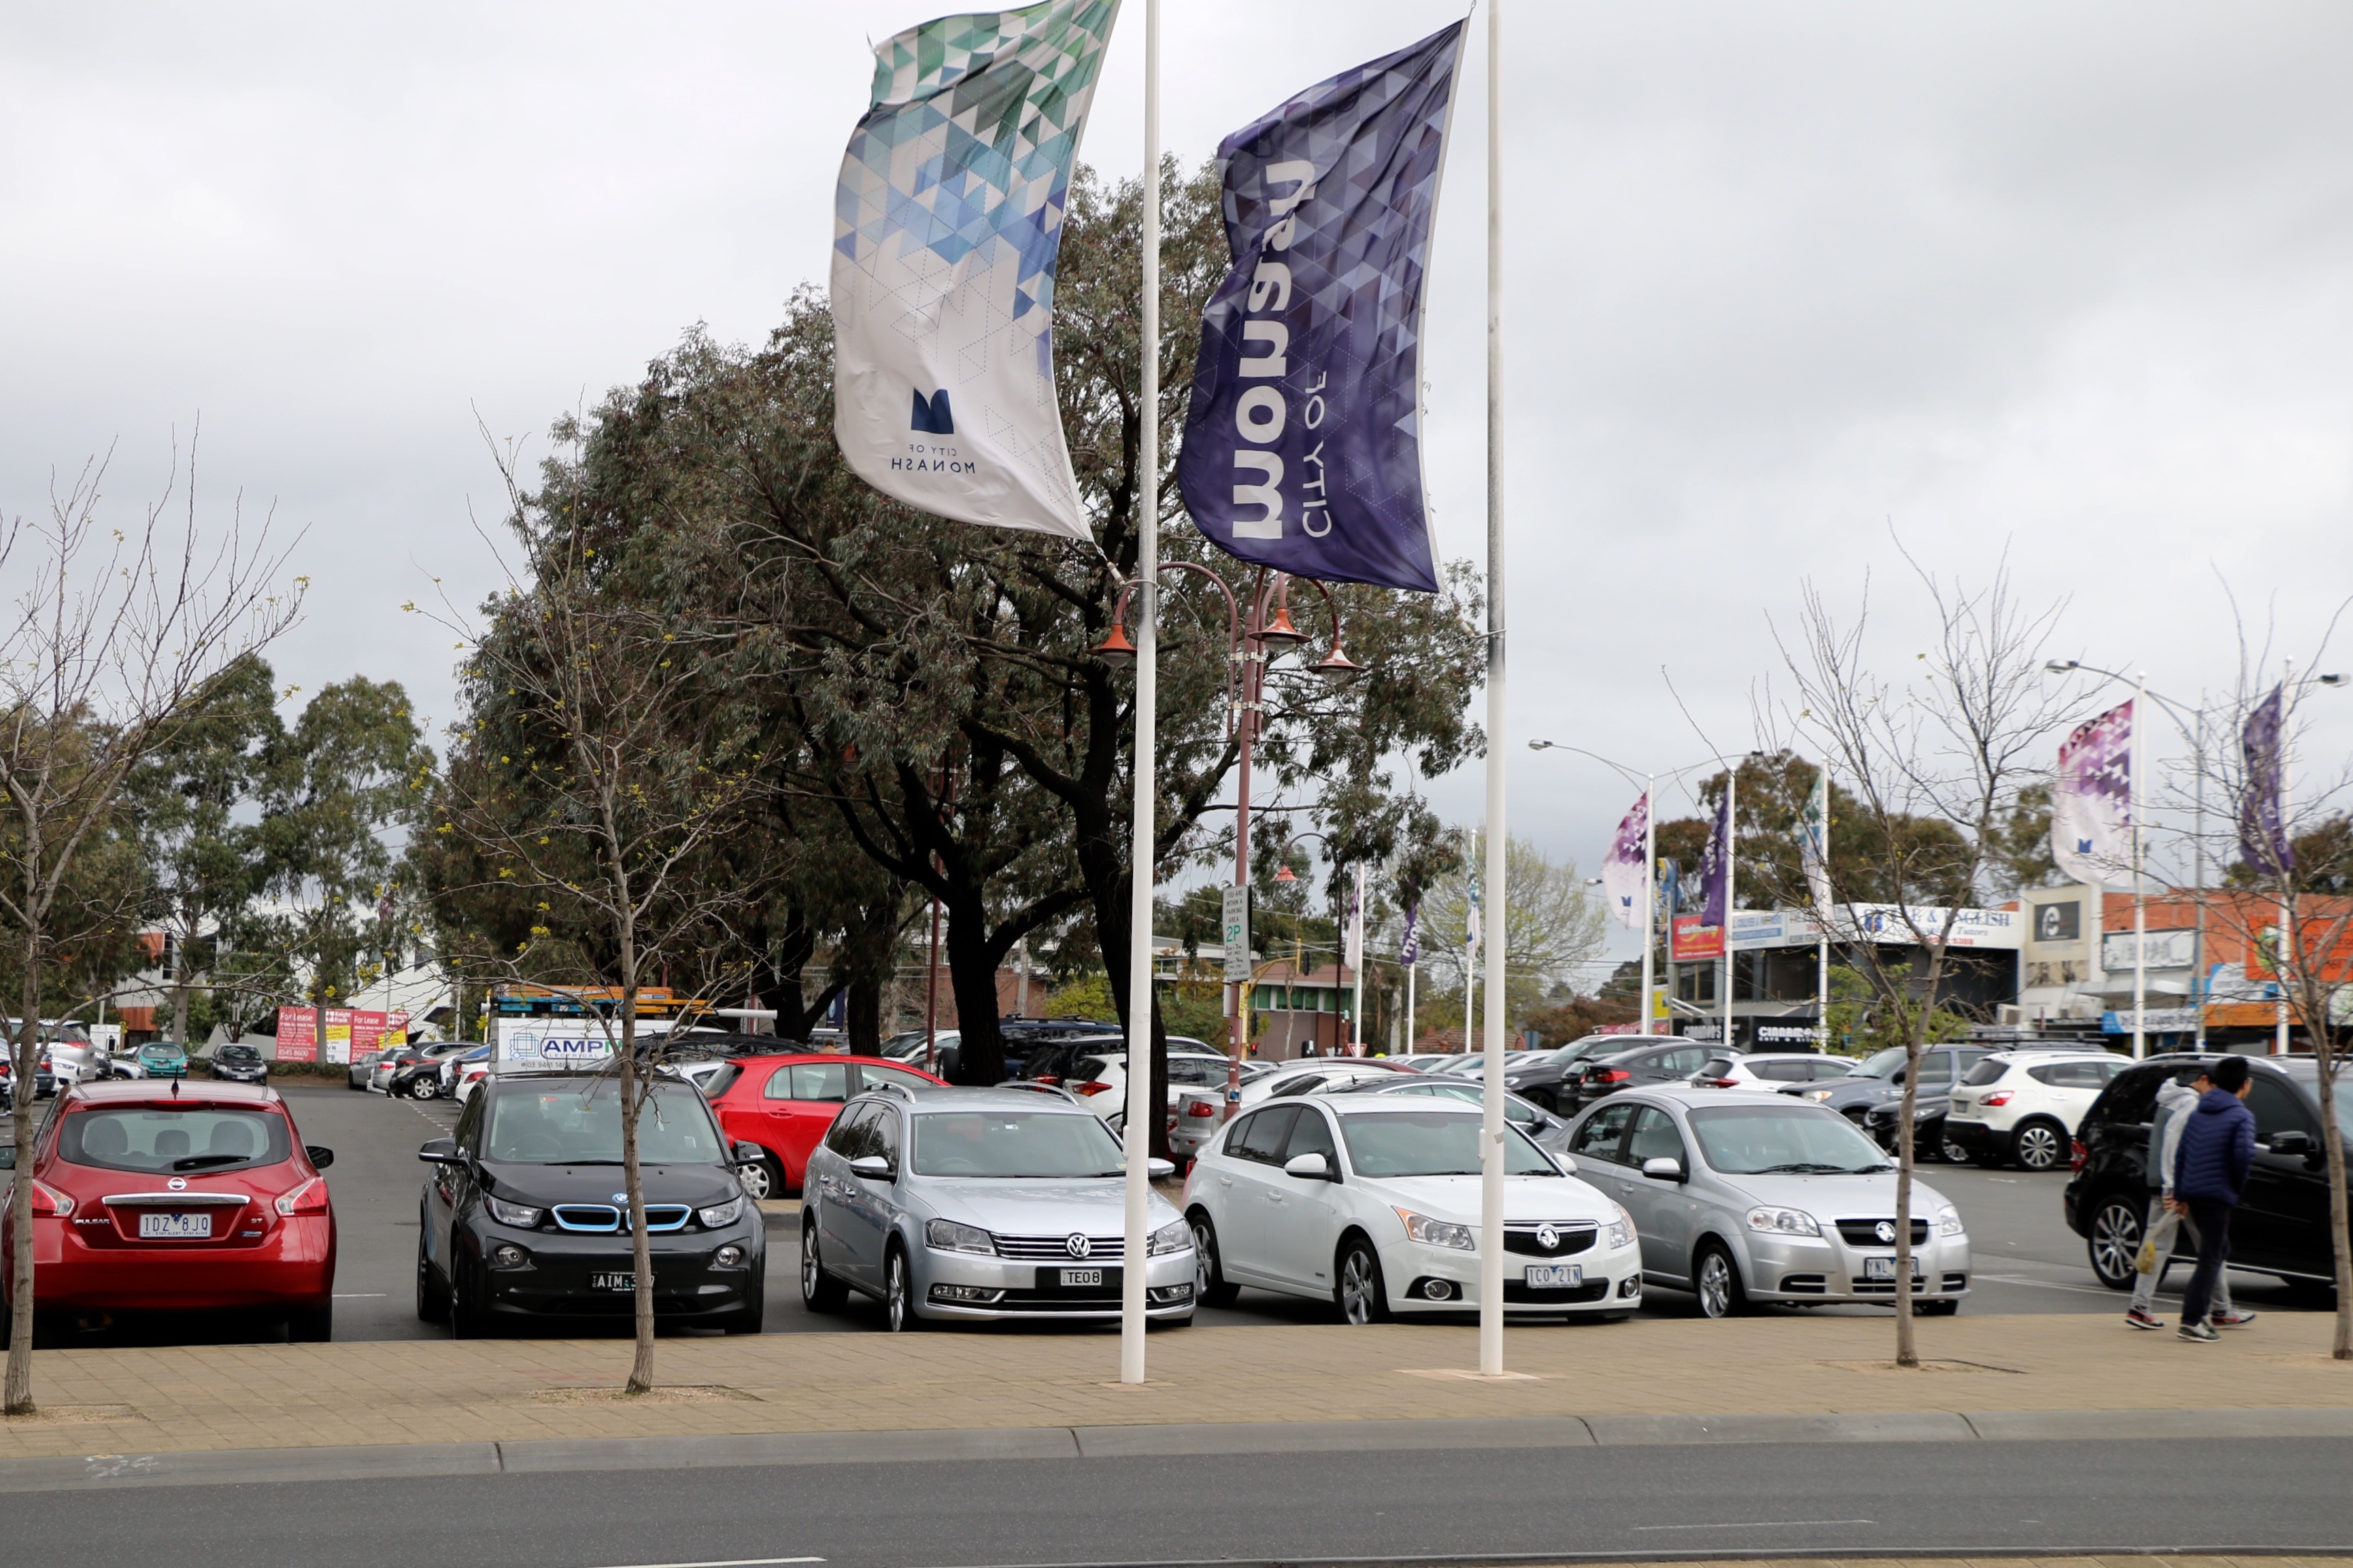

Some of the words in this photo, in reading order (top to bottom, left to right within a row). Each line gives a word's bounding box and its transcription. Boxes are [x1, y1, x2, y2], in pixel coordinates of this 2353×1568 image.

[1226, 925, 1241, 942] 2P
[280, 1012, 293, 1021] For
[293, 1012, 314, 1022] Lease
[354, 1015, 364, 1023] For
[365, 1016, 379, 1025] Lease
[145, 1217, 170, 1232] 1DZ
[182, 1217, 209, 1232] 8JQ
[597, 1275, 623, 1287] AIM
